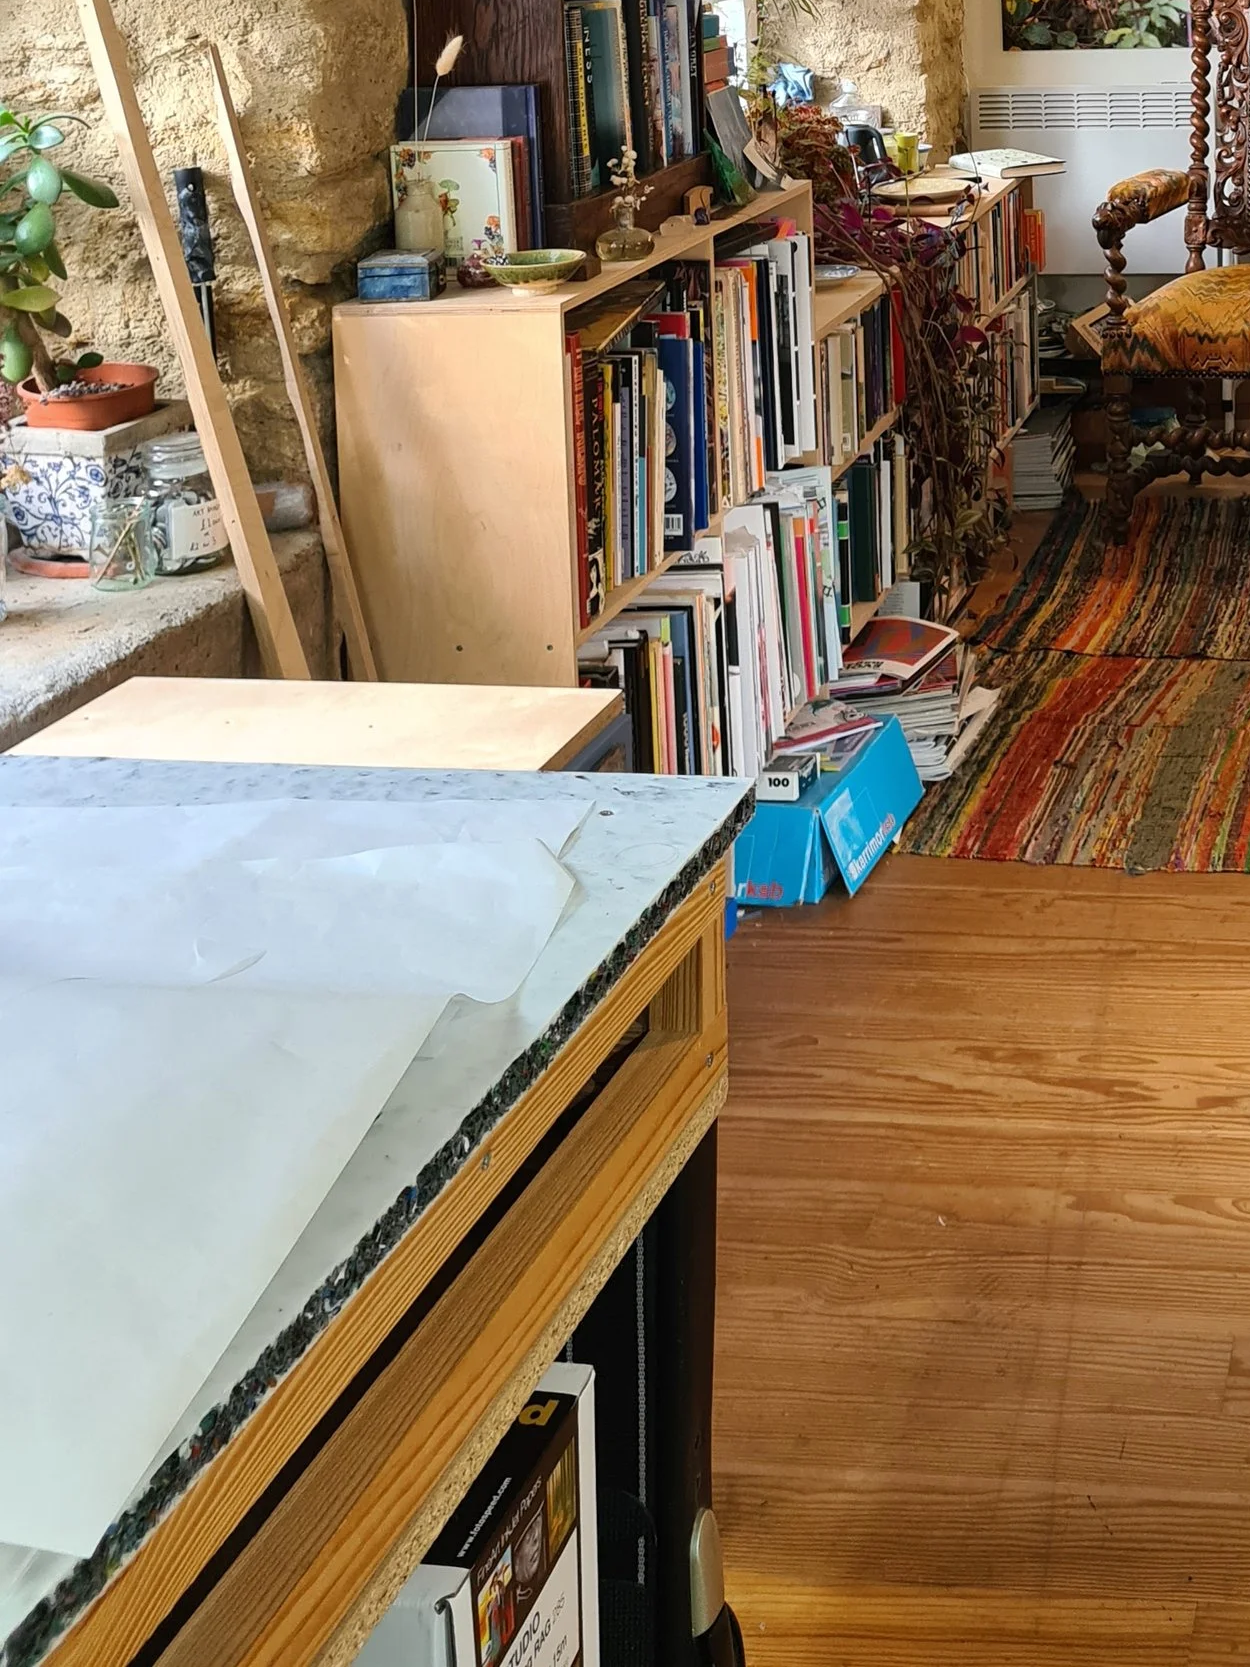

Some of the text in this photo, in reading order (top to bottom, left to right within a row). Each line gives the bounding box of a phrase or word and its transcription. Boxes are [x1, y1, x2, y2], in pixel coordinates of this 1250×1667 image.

[591, 398, 604, 515] PALOMAR
[768, 777, 790, 788] 100
[456, 1476, 512, 1558] www.fotospeed.com
